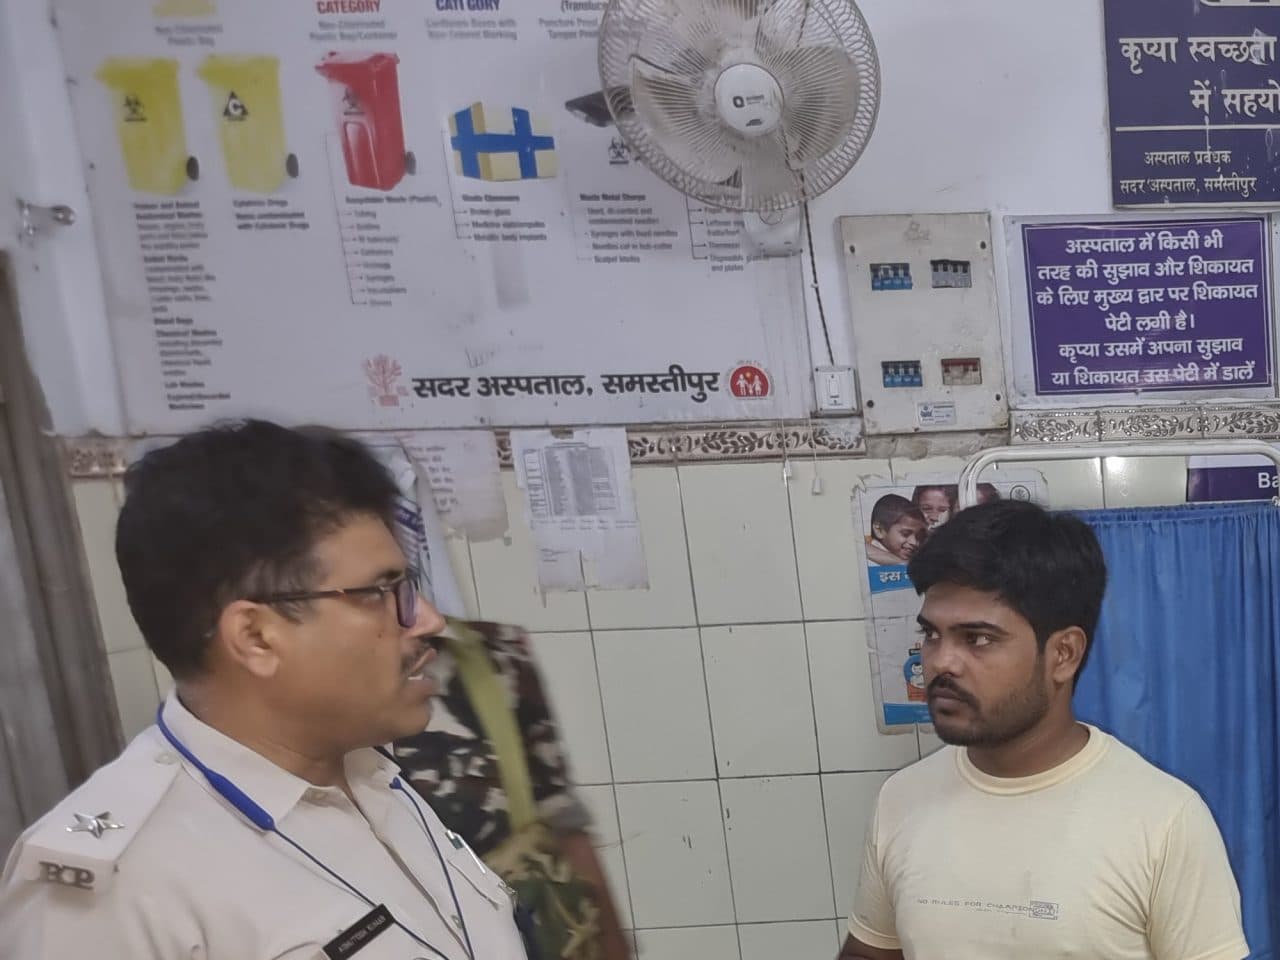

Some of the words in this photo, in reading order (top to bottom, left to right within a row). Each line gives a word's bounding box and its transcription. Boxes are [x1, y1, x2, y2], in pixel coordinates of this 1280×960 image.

[316, 0, 380, 13] CATEGORY
[1119, 37, 1178, 74] कृप्या
[1190, 80, 1211, 113] में
[1144, 151, 1190, 166] अस्पताल
[1120, 179, 1145, 194] सदर
[1204, 172, 1257, 197] समस्तीपुर
[1065, 237, 1135, 253] अस्पताल
[1139, 232, 1157, 251] में
[1158, 230, 1200, 251] किसी
[1204, 229, 1223, 249] भी
[1037, 265, 1071, 280] तरह
[1075, 259, 1098, 279] की
[1103, 262, 1150, 285] सुझाव
[1155, 259, 1185, 277] और
[1188, 255, 1254, 275] शिकायत
[1036, 287, 1053, 305] के
[1058, 286, 1089, 305] लिए
[1093, 289, 1133, 311] मुख्य
[1137, 288, 1164, 304] द्वार
[1167, 287, 1189, 301] पर
[1193, 282, 1258, 300] शिकायत
[1105, 312, 1132, 332] पेटी
[1136, 311, 1171, 331] लगी
[1058, 343, 1099, 363] कृप्या
[1104, 338, 1145, 357] उसमें
[1148, 340, 1192, 356] अपना
[1196, 338, 1243, 361] सुझाव
[411, 377, 471, 398] सदर
[477, 375, 593, 397] अस्पताल,
[600, 364, 721, 403] समस्तीपुर
[1052, 372, 1069, 386] या
[1074, 366, 1139, 385] शिकायत
[1203, 362, 1220, 380] में
[1223, 361, 1255, 380] डालें
[879, 568, 901, 583] इस
